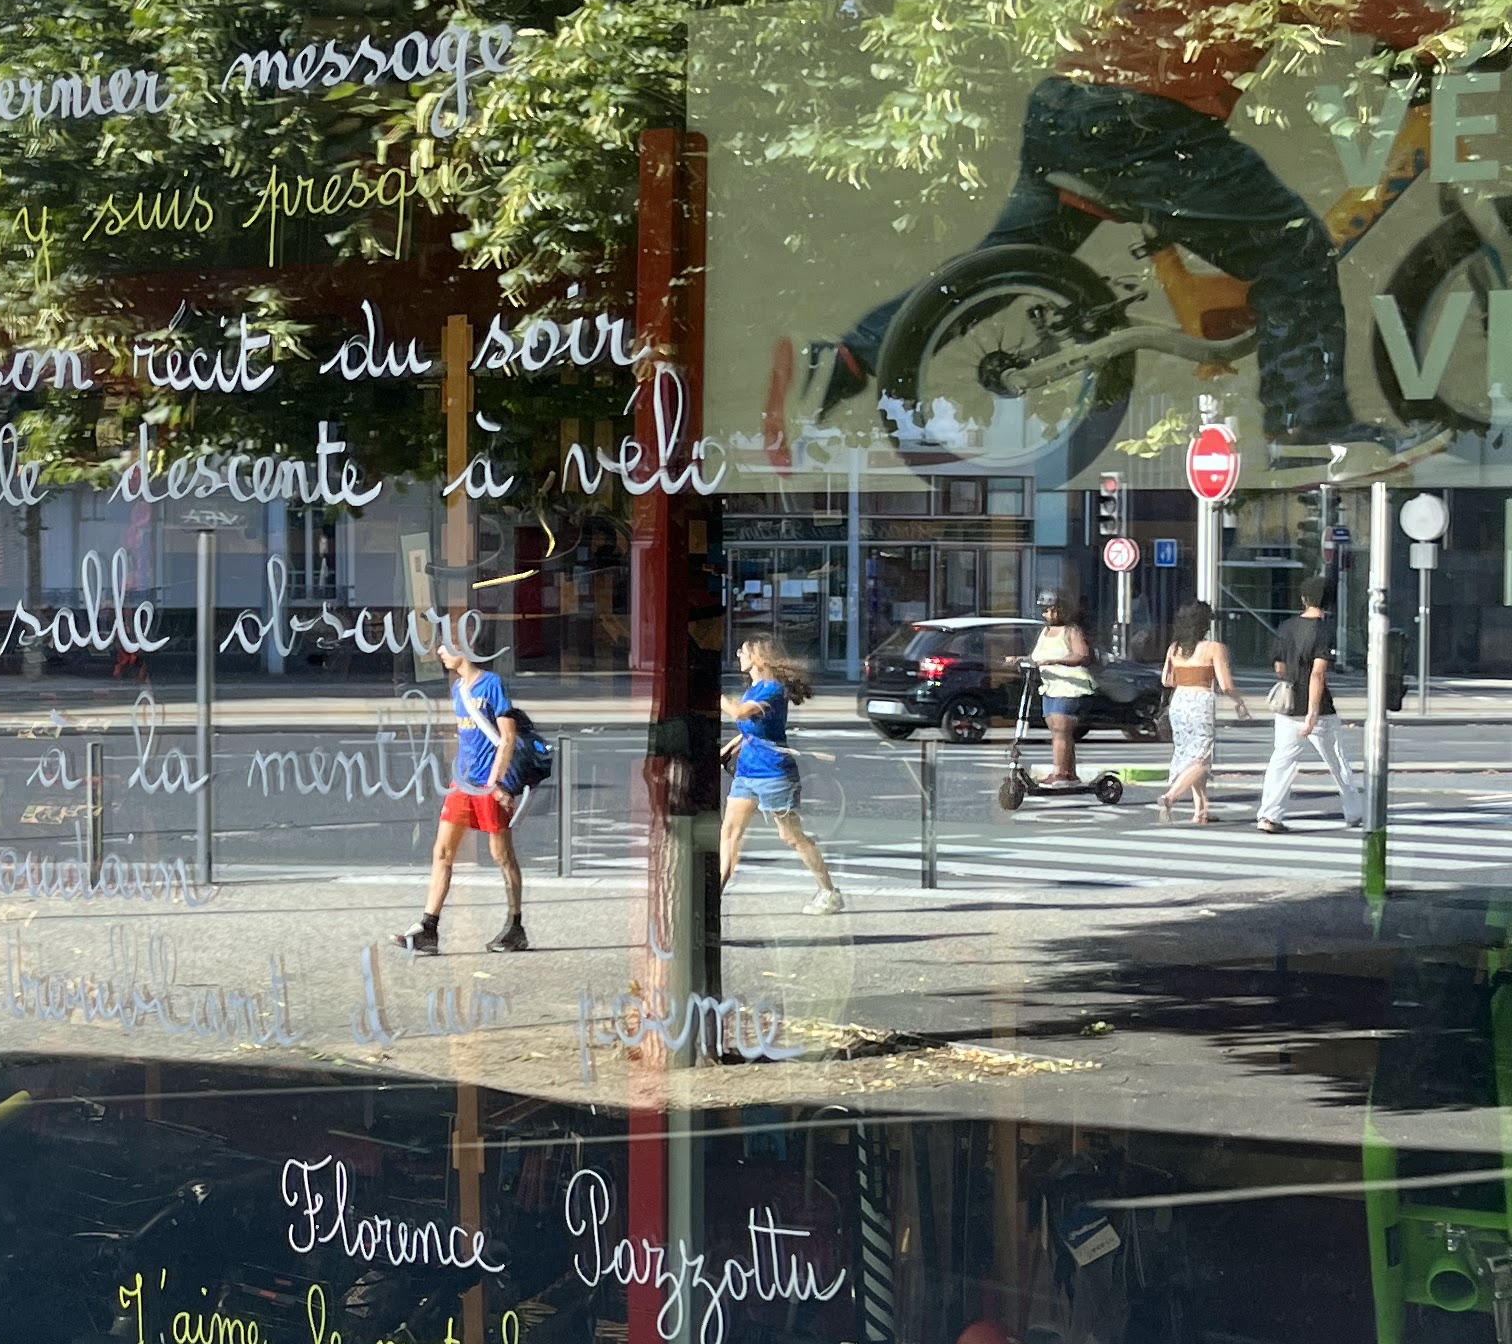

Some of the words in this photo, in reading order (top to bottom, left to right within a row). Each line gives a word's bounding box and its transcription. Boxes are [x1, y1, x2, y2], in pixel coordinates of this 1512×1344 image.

[222, 23, 514, 139] message
[82, 168, 215, 242] suis
[243, 161, 490, 268] presque
[131, 299, 276, 394] récit
[318, 299, 433, 381] du
[469, 282, 654, 372] soir
[107, 420, 383, 507] descente
[442, 411, 514, 499] à
[562, 360, 728, 496] vélo
[0, 546, 171, 657] salle
[219, 553, 511, 663] obscure
[26, 708, 82, 790] à
[128, 690, 210, 794] la
[281, 1154, 506, 1274] Florence
